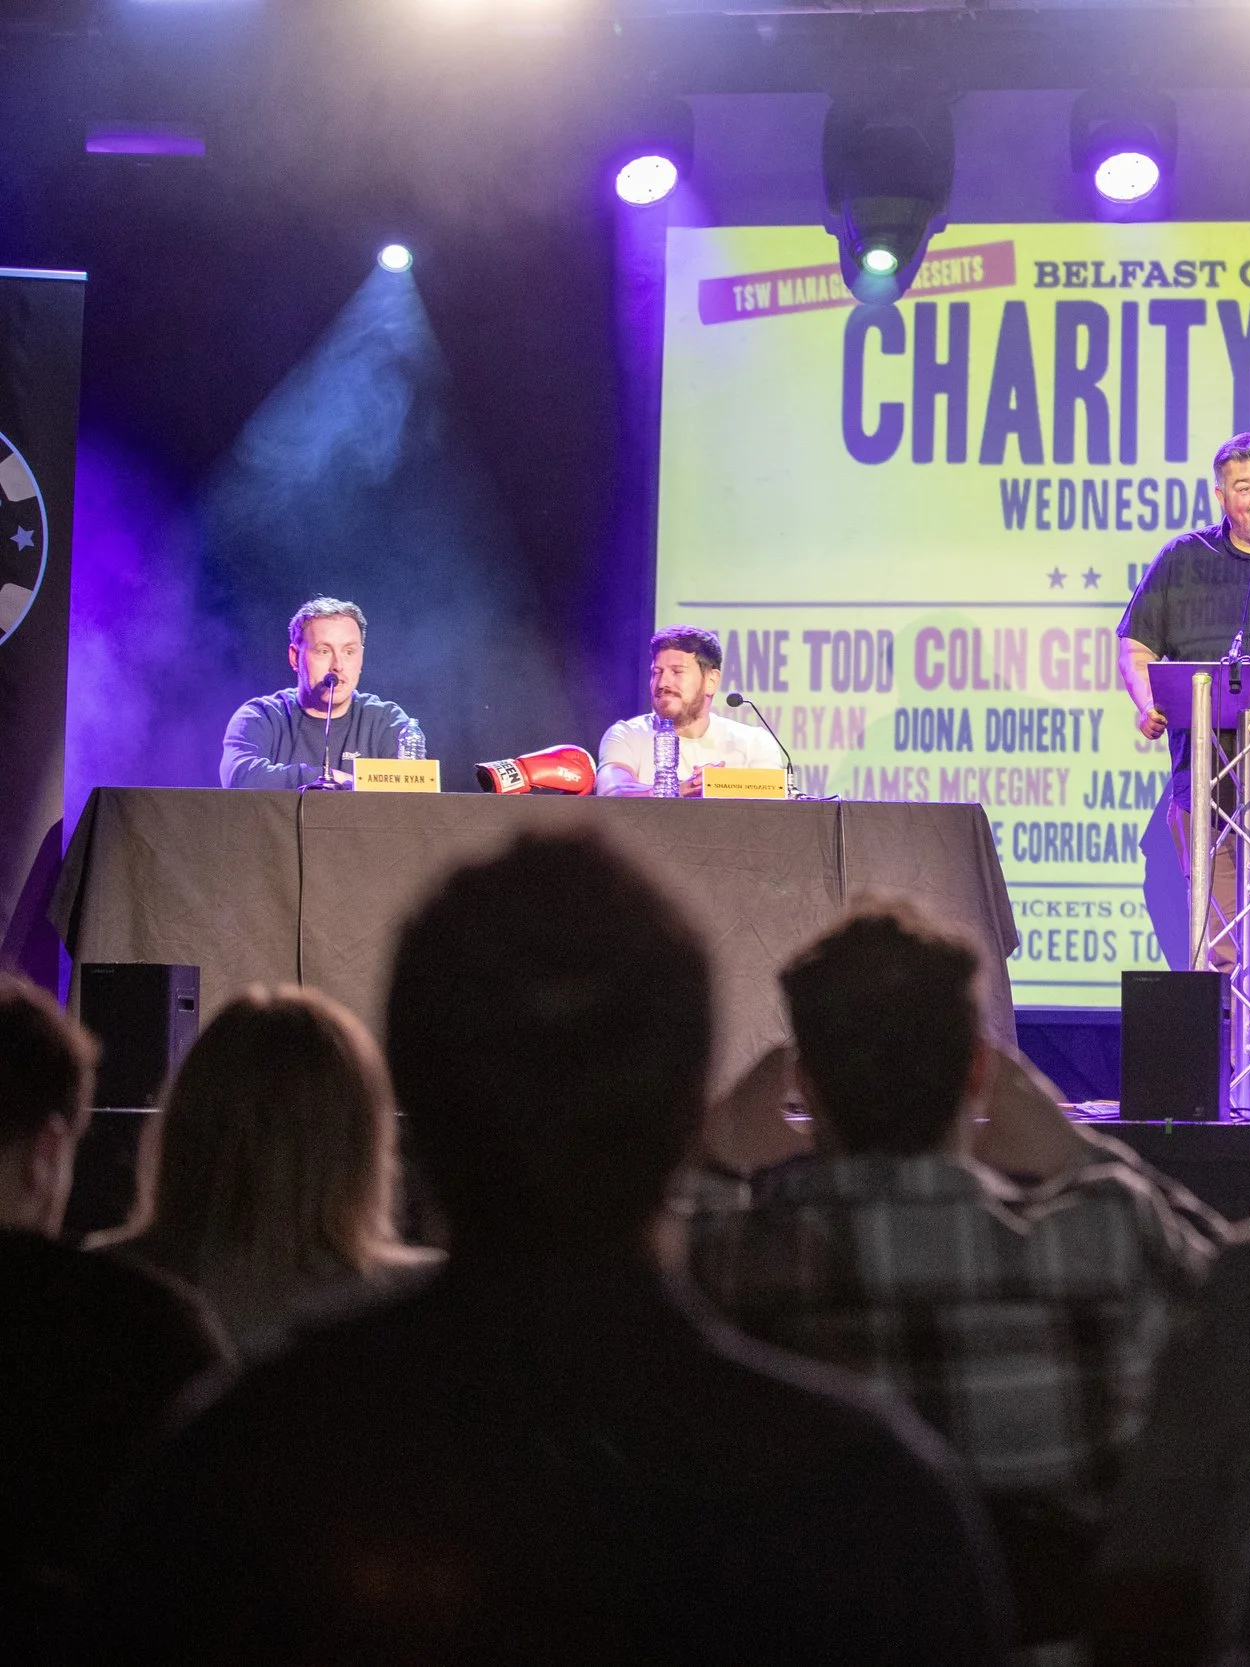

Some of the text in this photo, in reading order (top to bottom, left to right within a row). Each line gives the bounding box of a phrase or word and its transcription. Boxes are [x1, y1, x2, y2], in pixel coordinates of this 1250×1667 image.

[1034, 260, 1226, 289] BELFAST
[733, 280, 772, 312] TSW
[1000, 477, 1213, 532] WEDNESDA
[715, 629, 790, 693] ANE
[802, 629, 894, 694] TODD
[914, 625, 1028, 692] COLIN
[792, 706, 866, 751] RYAN
[894, 706, 974, 754] DIONA
[985, 706, 1104, 754] DOHERTY
[367, 774, 425, 784] ANDREW RYAN
[844, 766, 930, 802] JAMES
[939, 765, 1070, 807] MCKEGNEY
[1012, 821, 1138, 864] CORRIGAN
